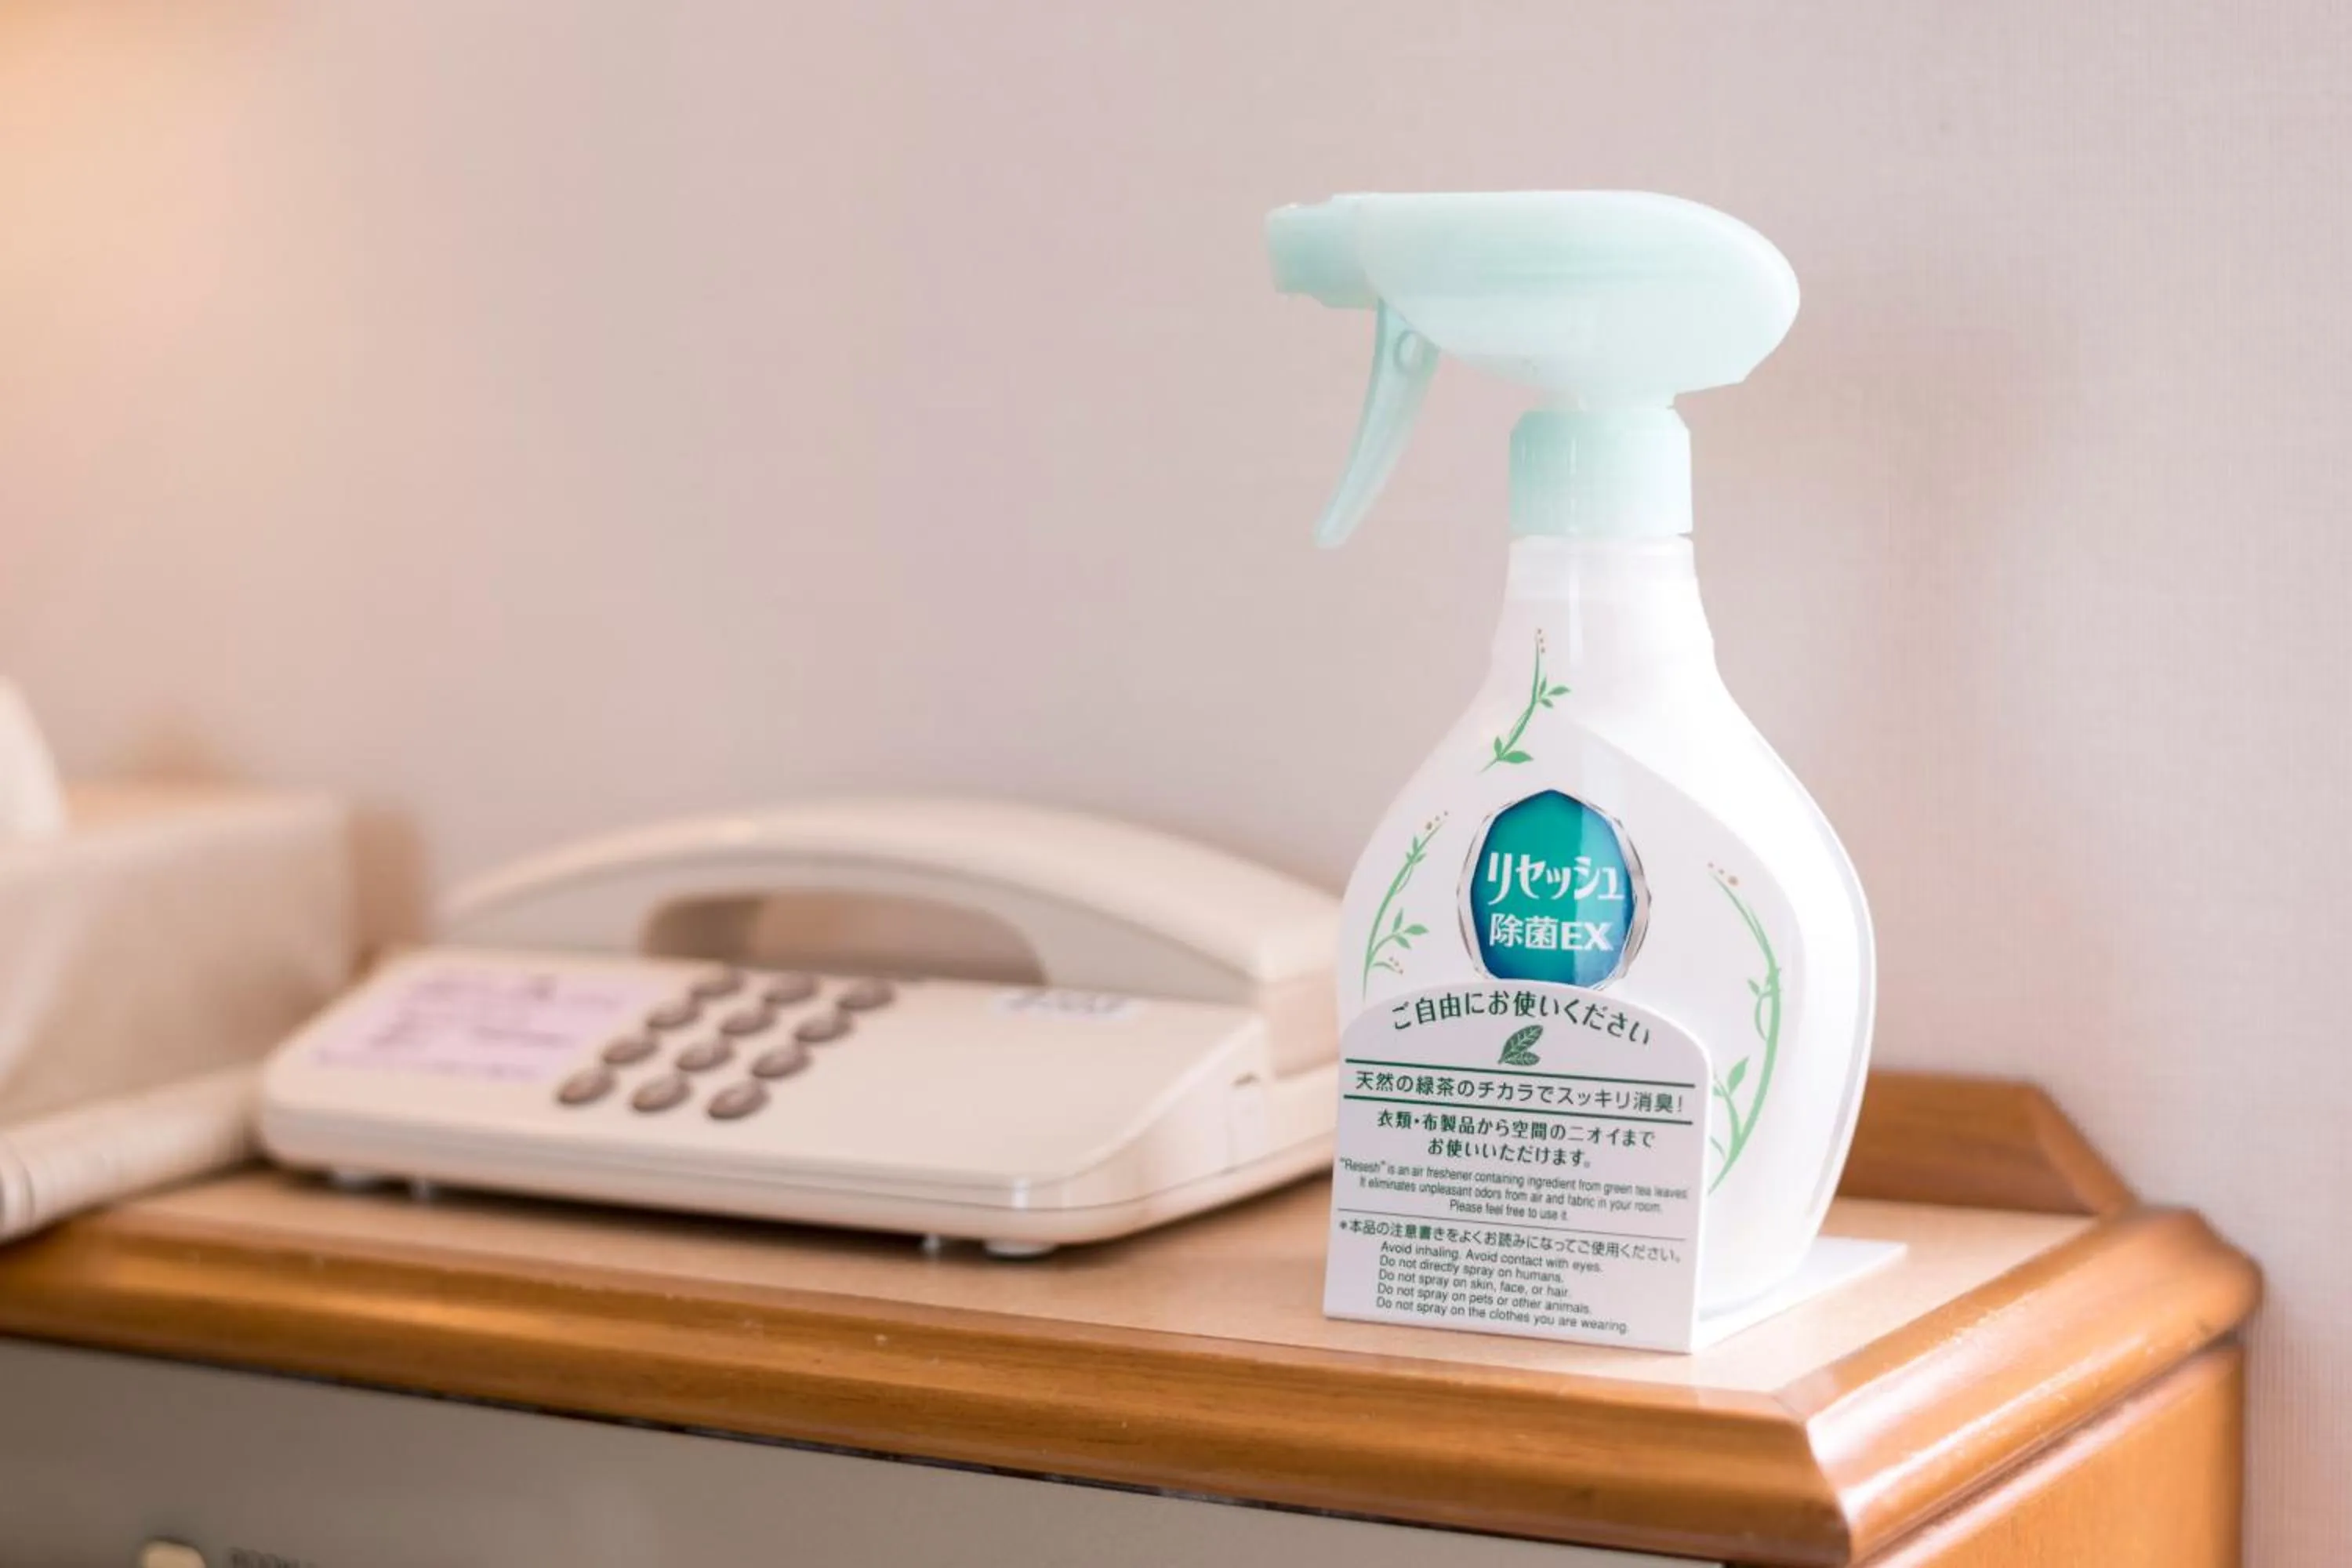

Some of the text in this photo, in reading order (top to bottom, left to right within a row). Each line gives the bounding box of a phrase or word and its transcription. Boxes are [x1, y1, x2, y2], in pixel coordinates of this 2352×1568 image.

[1487, 852, 1624, 906] リセッシュ
[1490, 913, 1613, 951] 除菌EX
[1392, 989, 1650, 1045] ご自由にお使いください
[1428, 1138, 1592, 1169] お使いいただけます。
[1368, 1178, 1415, 1192] eliminates
[1419, 1182, 1472, 1197] unpleasant
[1475, 1187, 1501, 1200] odors
[1504, 1189, 1527, 1201] from
[1530, 1192, 1542, 1203] air
[1545, 1192, 1565, 1205] and
[1568, 1194, 1595, 1207] fabric
[1598, 1197, 1606, 1208] in
[1610, 1200, 1632, 1212] your
[1388, 1164, 1395, 1174] is
[1398, 1166, 1410, 1176] an
[1411, 1166, 1423, 1177] air
[1426, 1166, 1472, 1181] freshener
[1475, 1171, 1524, 1187] containing
[1527, 1176, 1575, 1190] ingredient
[1579, 1179, 1601, 1191] from
[1603, 1183, 1632, 1196] green
[1635, 1184, 1651, 1196] tea
[1450, 1199, 1483, 1214] Please
[1486, 1203, 1503, 1214] feel
[1506, 1205, 1525, 1217] free
[1528, 1207, 1537, 1218] to
[1540, 1209, 1558, 1220] use
[1379, 1254, 1564, 1283] Do not directly spray on humans.
[1381, 1240, 1412, 1254] Avoid
[1465, 1249, 1497, 1263] Avoid
[1501, 1254, 1542, 1268] contact
[1545, 1258, 1569, 1269] with
[1572, 1261, 1603, 1273] eyes.
[1378, 1269, 1395, 1280] Do
[1398, 1273, 1415, 1283] not
[1418, 1274, 1450, 1287] spray
[1453, 1277, 1467, 1287] on
[1470, 1278, 1496, 1292] skin,
[1500, 1280, 1528, 1294] face,
[1531, 1283, 1543, 1294] or
[1376, 1296, 1630, 1334] Do not spray on the clothes you are wearing.
[1377, 1283, 1592, 1315] Do not spray on pets or other animals.
